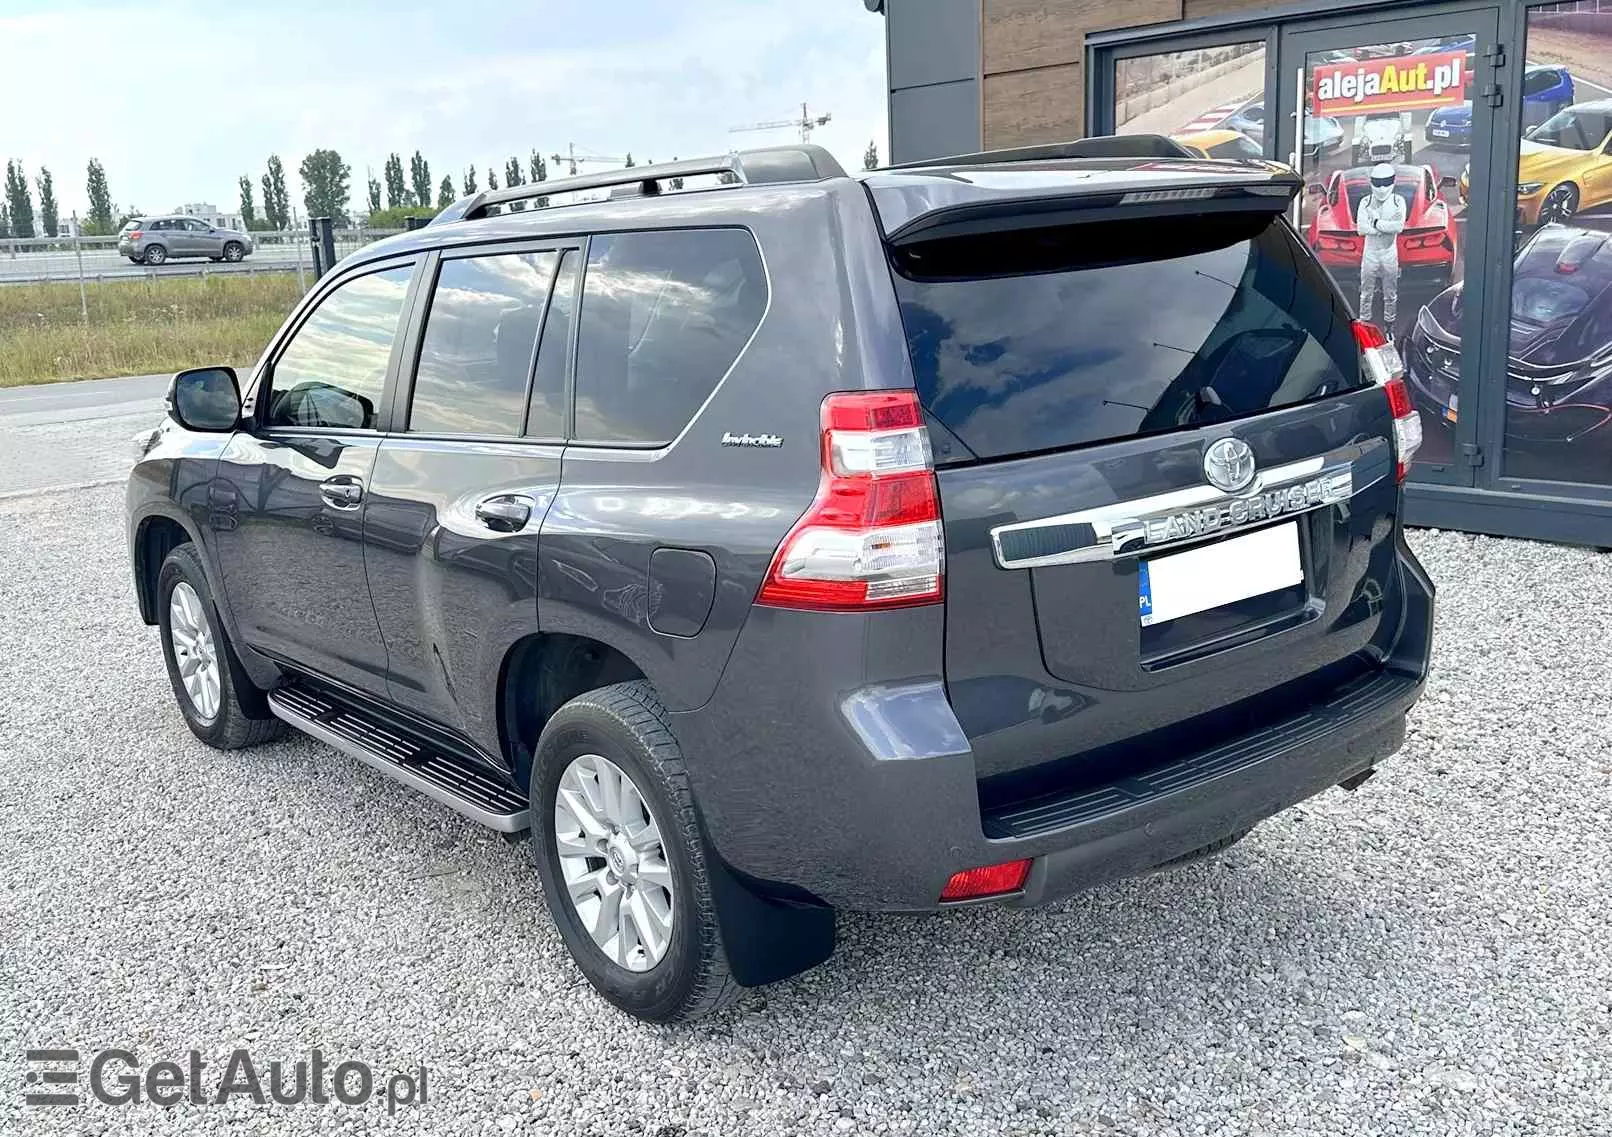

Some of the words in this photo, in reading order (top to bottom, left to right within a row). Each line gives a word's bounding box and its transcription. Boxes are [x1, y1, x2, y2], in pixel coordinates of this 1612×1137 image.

[1318, 58, 1460, 102] alejaAut.pl
[1144, 509, 1220, 544] LAND
[1229, 479, 1335, 526] CRUISER
[1139, 595, 1152, 609] PL
